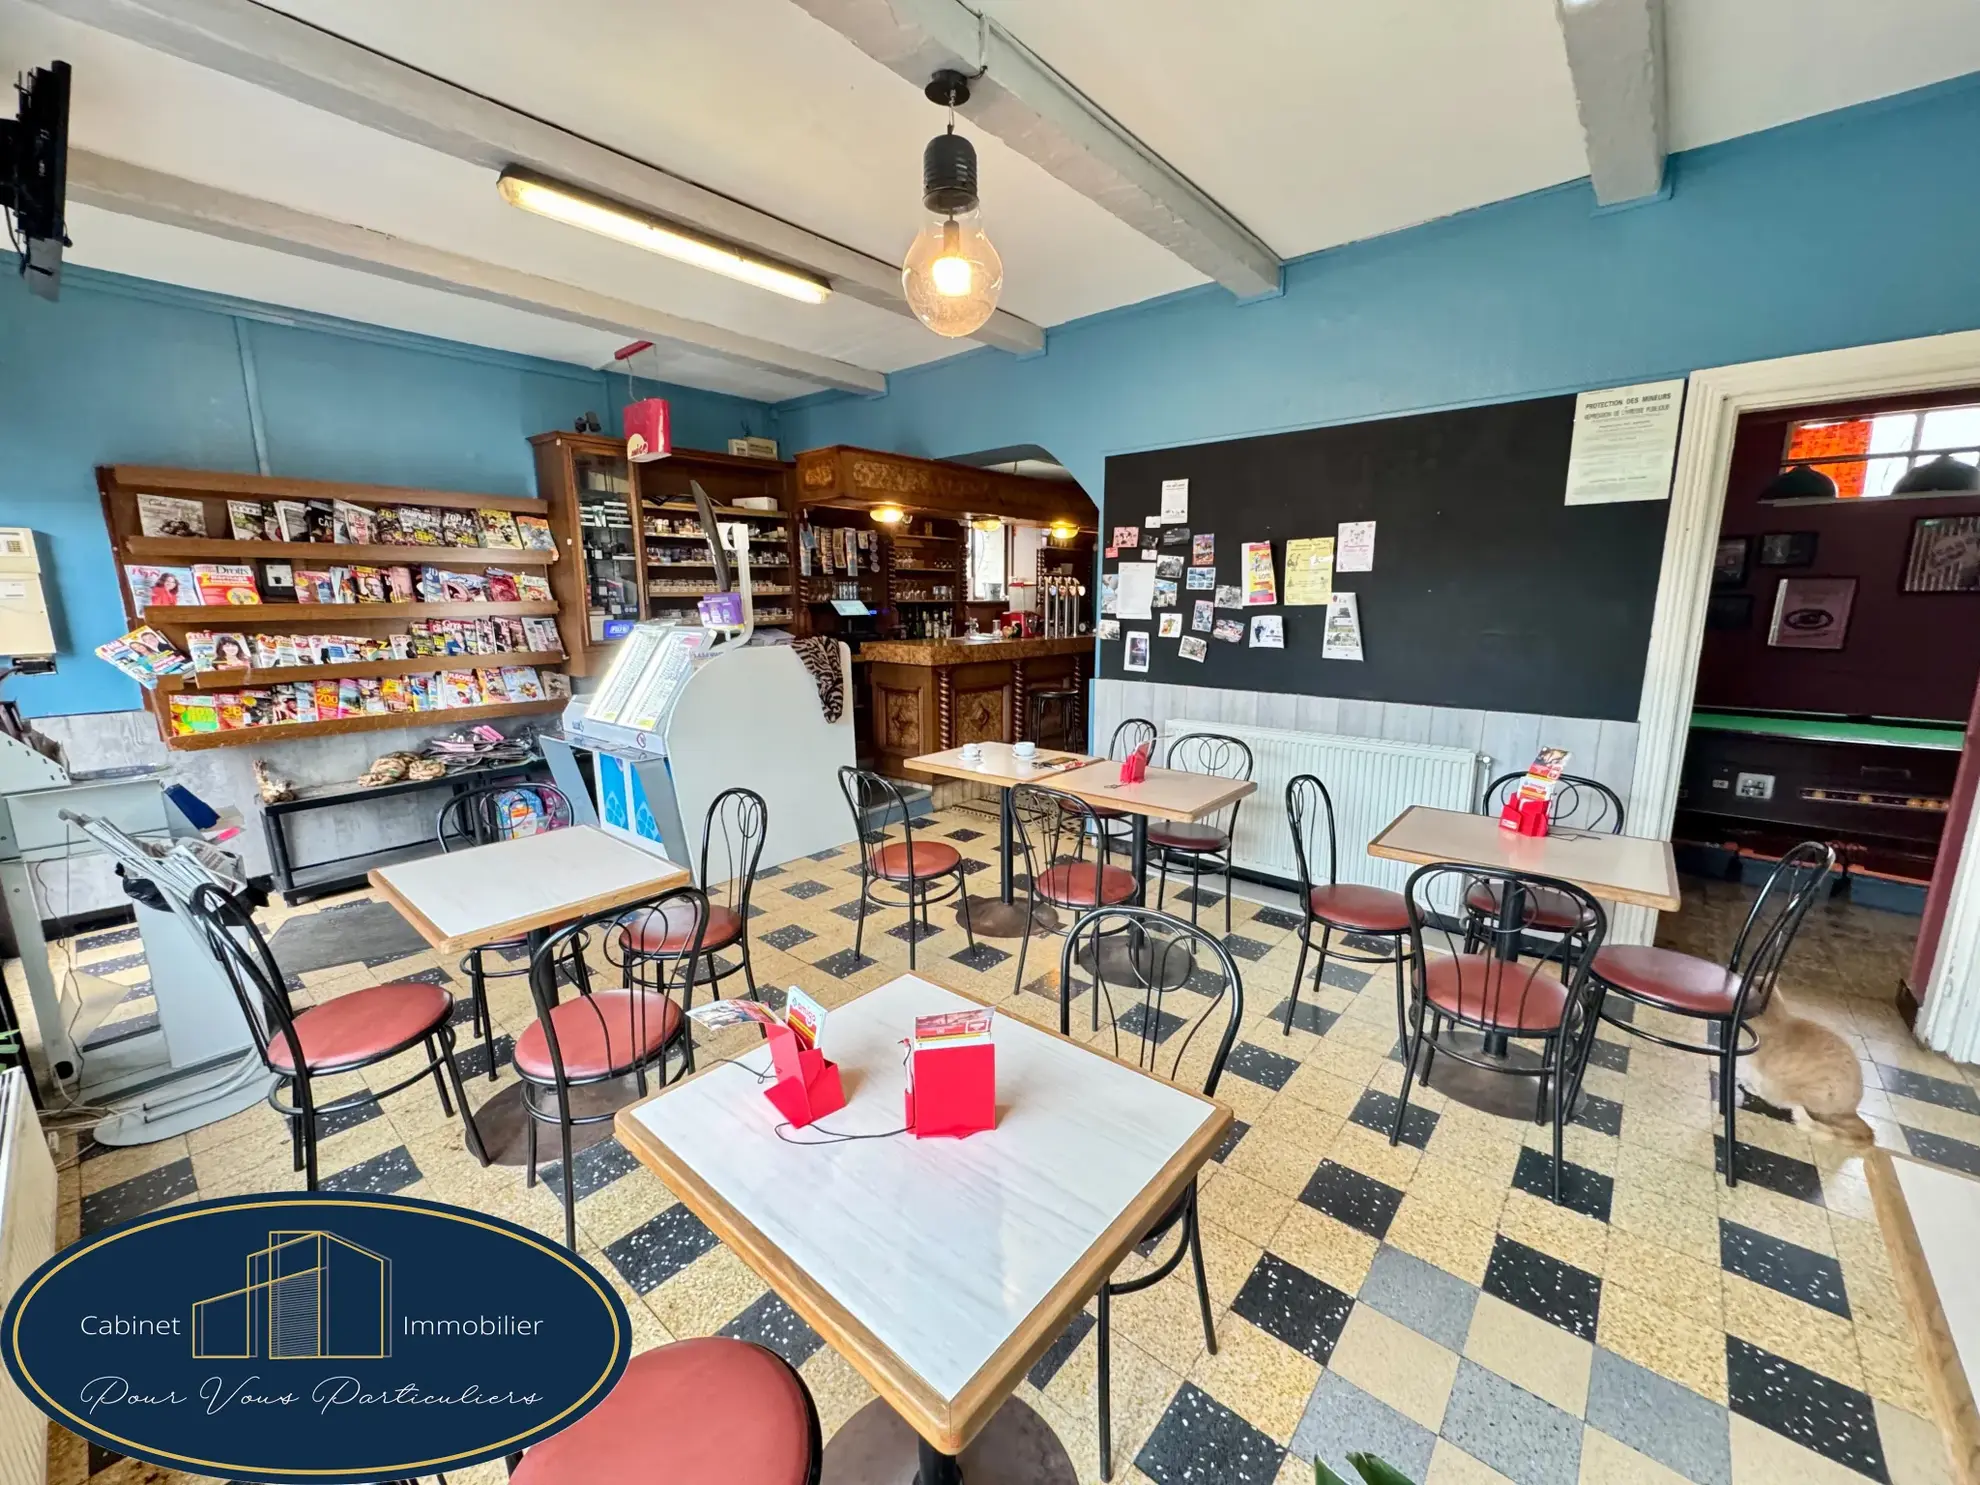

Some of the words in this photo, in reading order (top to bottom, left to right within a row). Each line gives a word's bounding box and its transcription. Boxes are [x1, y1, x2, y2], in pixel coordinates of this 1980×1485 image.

[1585, 400, 1623, 409] PROTECTION
[1626, 397, 1639, 405] DES
[1642, 393, 1672, 403] MINEURS
[445, 512, 462, 522] TOP
[215, 565, 249, 576] Droits
